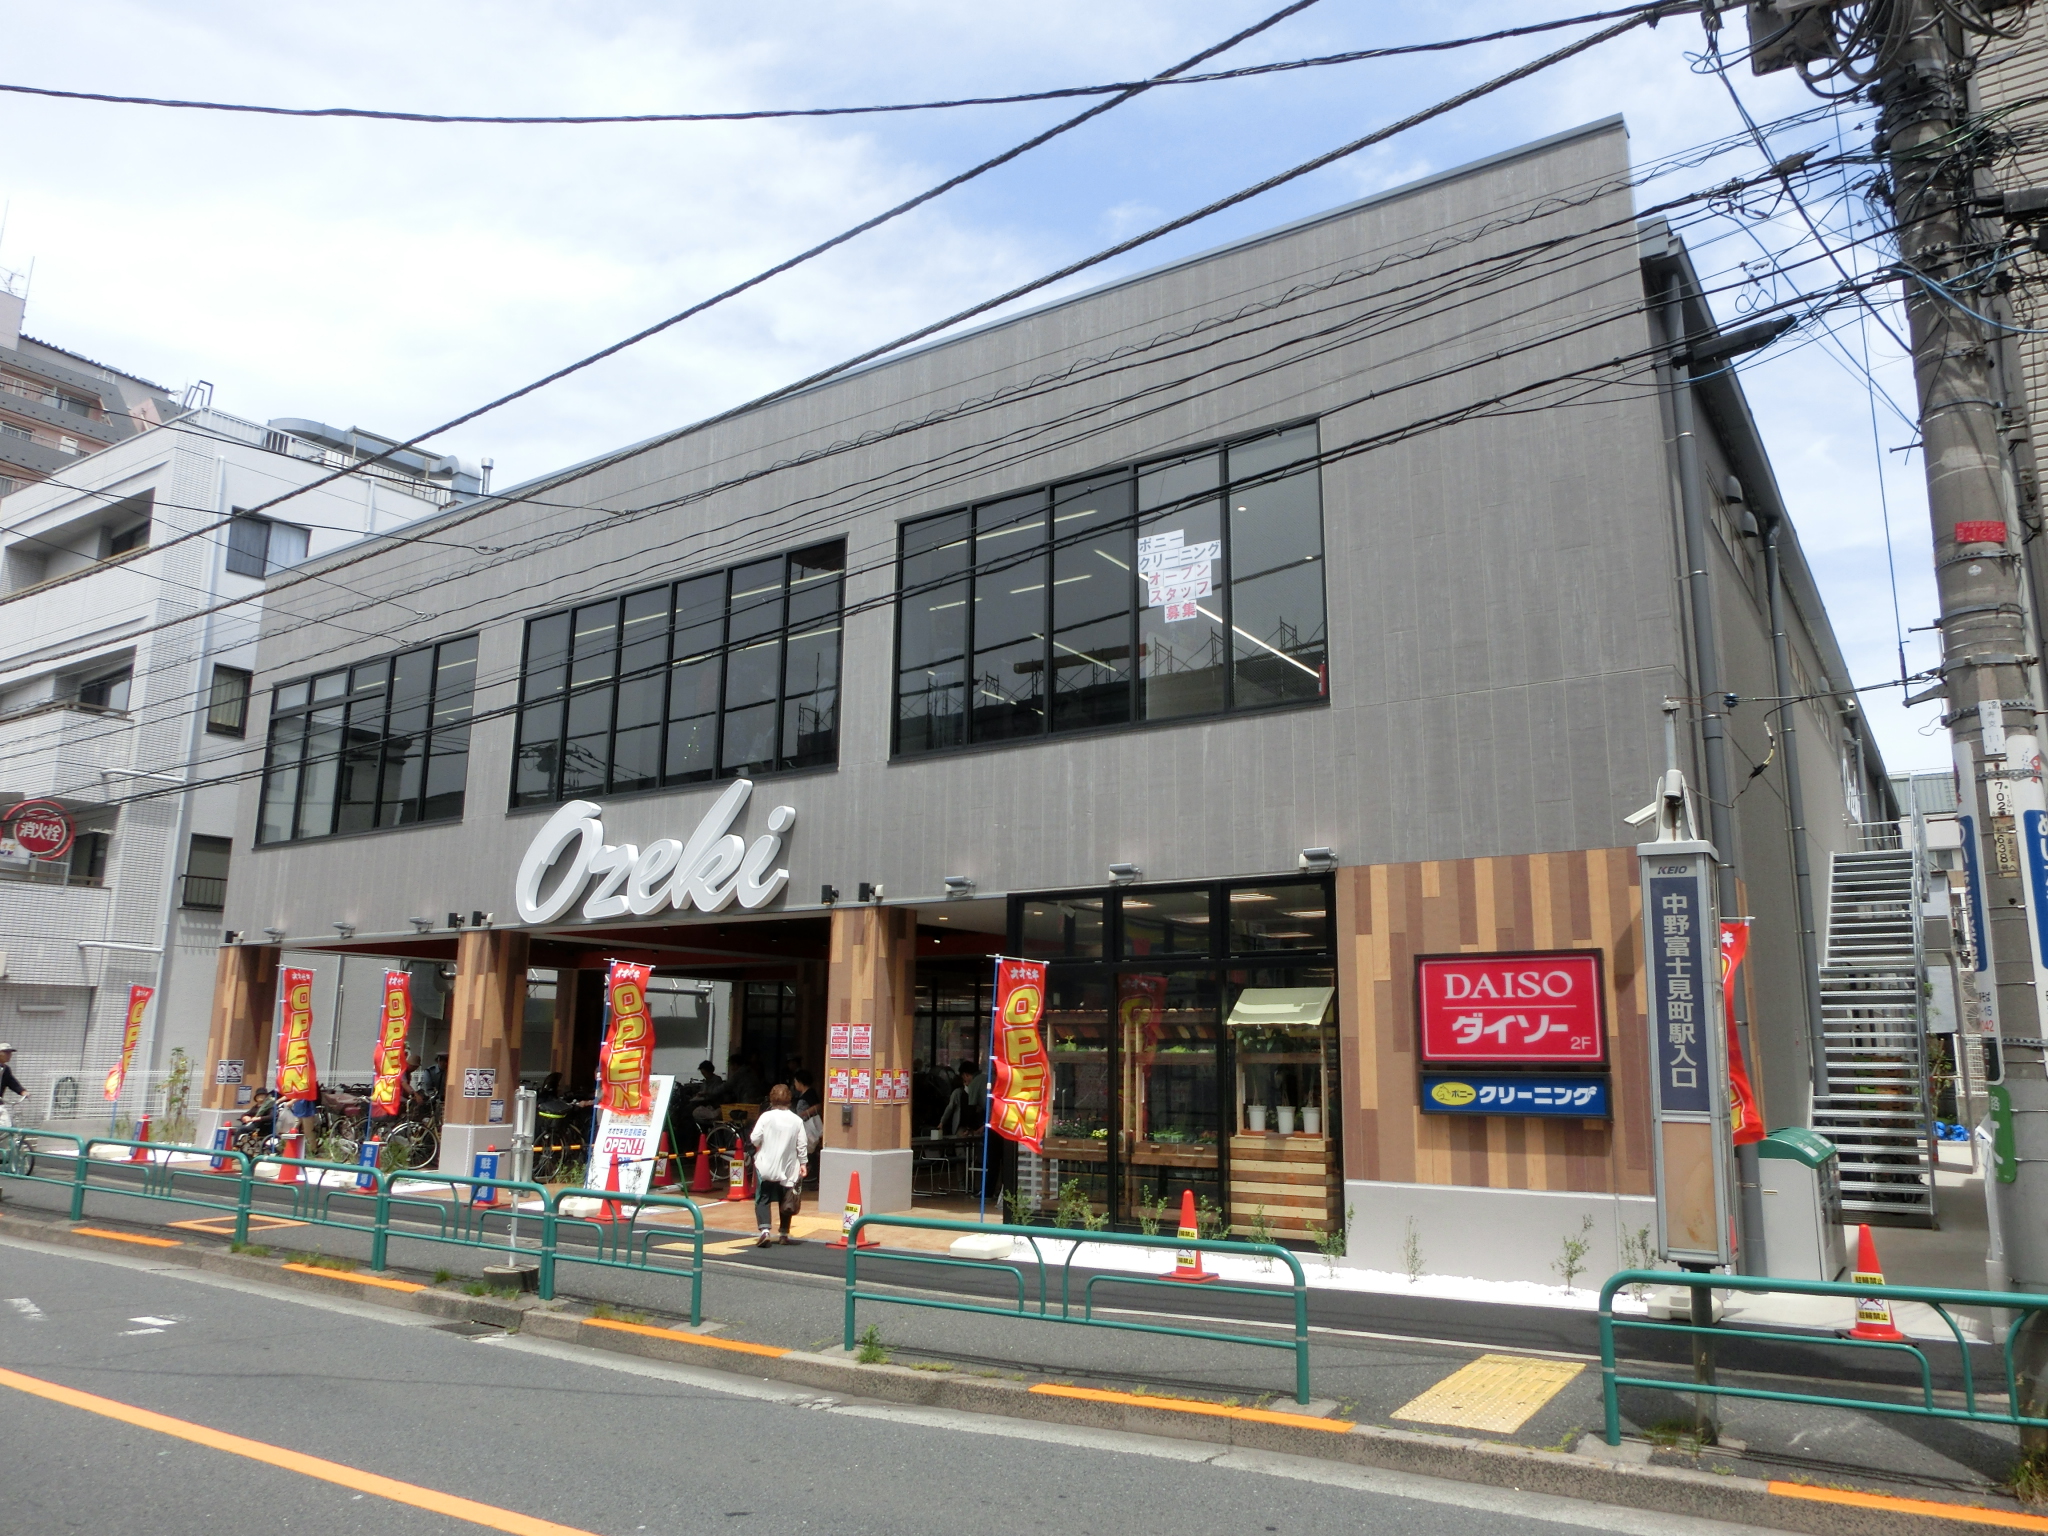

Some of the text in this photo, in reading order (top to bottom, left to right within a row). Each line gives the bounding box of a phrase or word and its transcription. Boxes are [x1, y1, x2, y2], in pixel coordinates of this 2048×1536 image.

[1139, 535, 1184, 552] ポニー
[1139, 541, 1220, 571] クリーニング
[1149, 564, 1209, 586] オープン
[1150, 580, 1209, 603] スタッフ
[1166, 601, 1197, 620] 募集
[19, 821, 62, 842] 消火栓
[516, 779, 797, 924] Ozeki
[1657, 865, 1688, 875] KEIO
[1010, 967, 1040, 982] オオゼキ
[1443, 970, 1573, 999] DAISO
[1662, 892, 1698, 1089] 中野富士見町駅入口
[283, 984, 311, 1094] OPEN
[1452, 1012, 1569, 1045] ダイソー
[371, 989, 406, 1105] OPEN
[607, 981, 646, 1111] OPEN
[1570, 1036, 1592, 1050] 2F
[998, 984, 1046, 1141] OPEN
[1451, 1089, 1473, 1099] ポニー
[1478, 1085, 1598, 1106] クリーニング
[604, 1137, 646, 1155] OPEN!!
